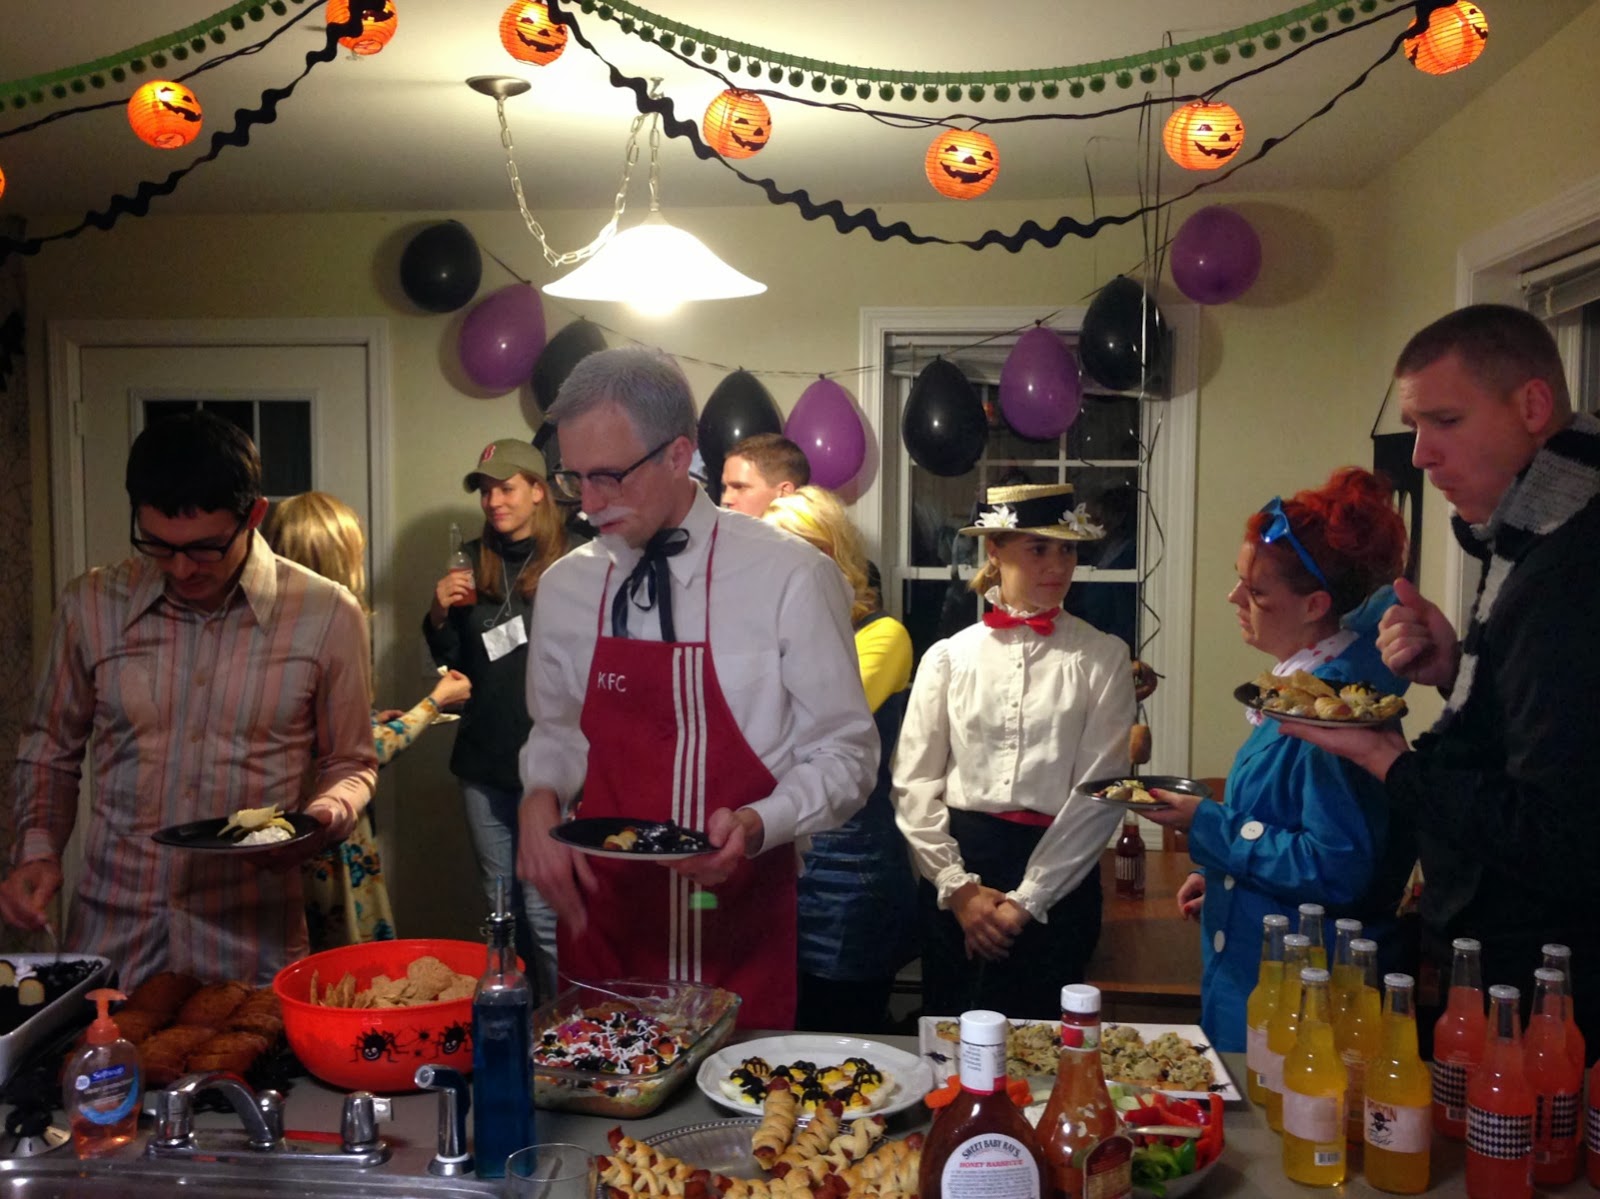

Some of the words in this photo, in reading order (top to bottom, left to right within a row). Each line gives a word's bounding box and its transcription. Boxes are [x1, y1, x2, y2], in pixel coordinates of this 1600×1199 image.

[597, 671, 627, 692] KFC
[962, 1141, 983, 1160] SWEET
[983, 1139, 1002, 1148] BABY
[1002, 1141, 1021, 1158] RAY'S
